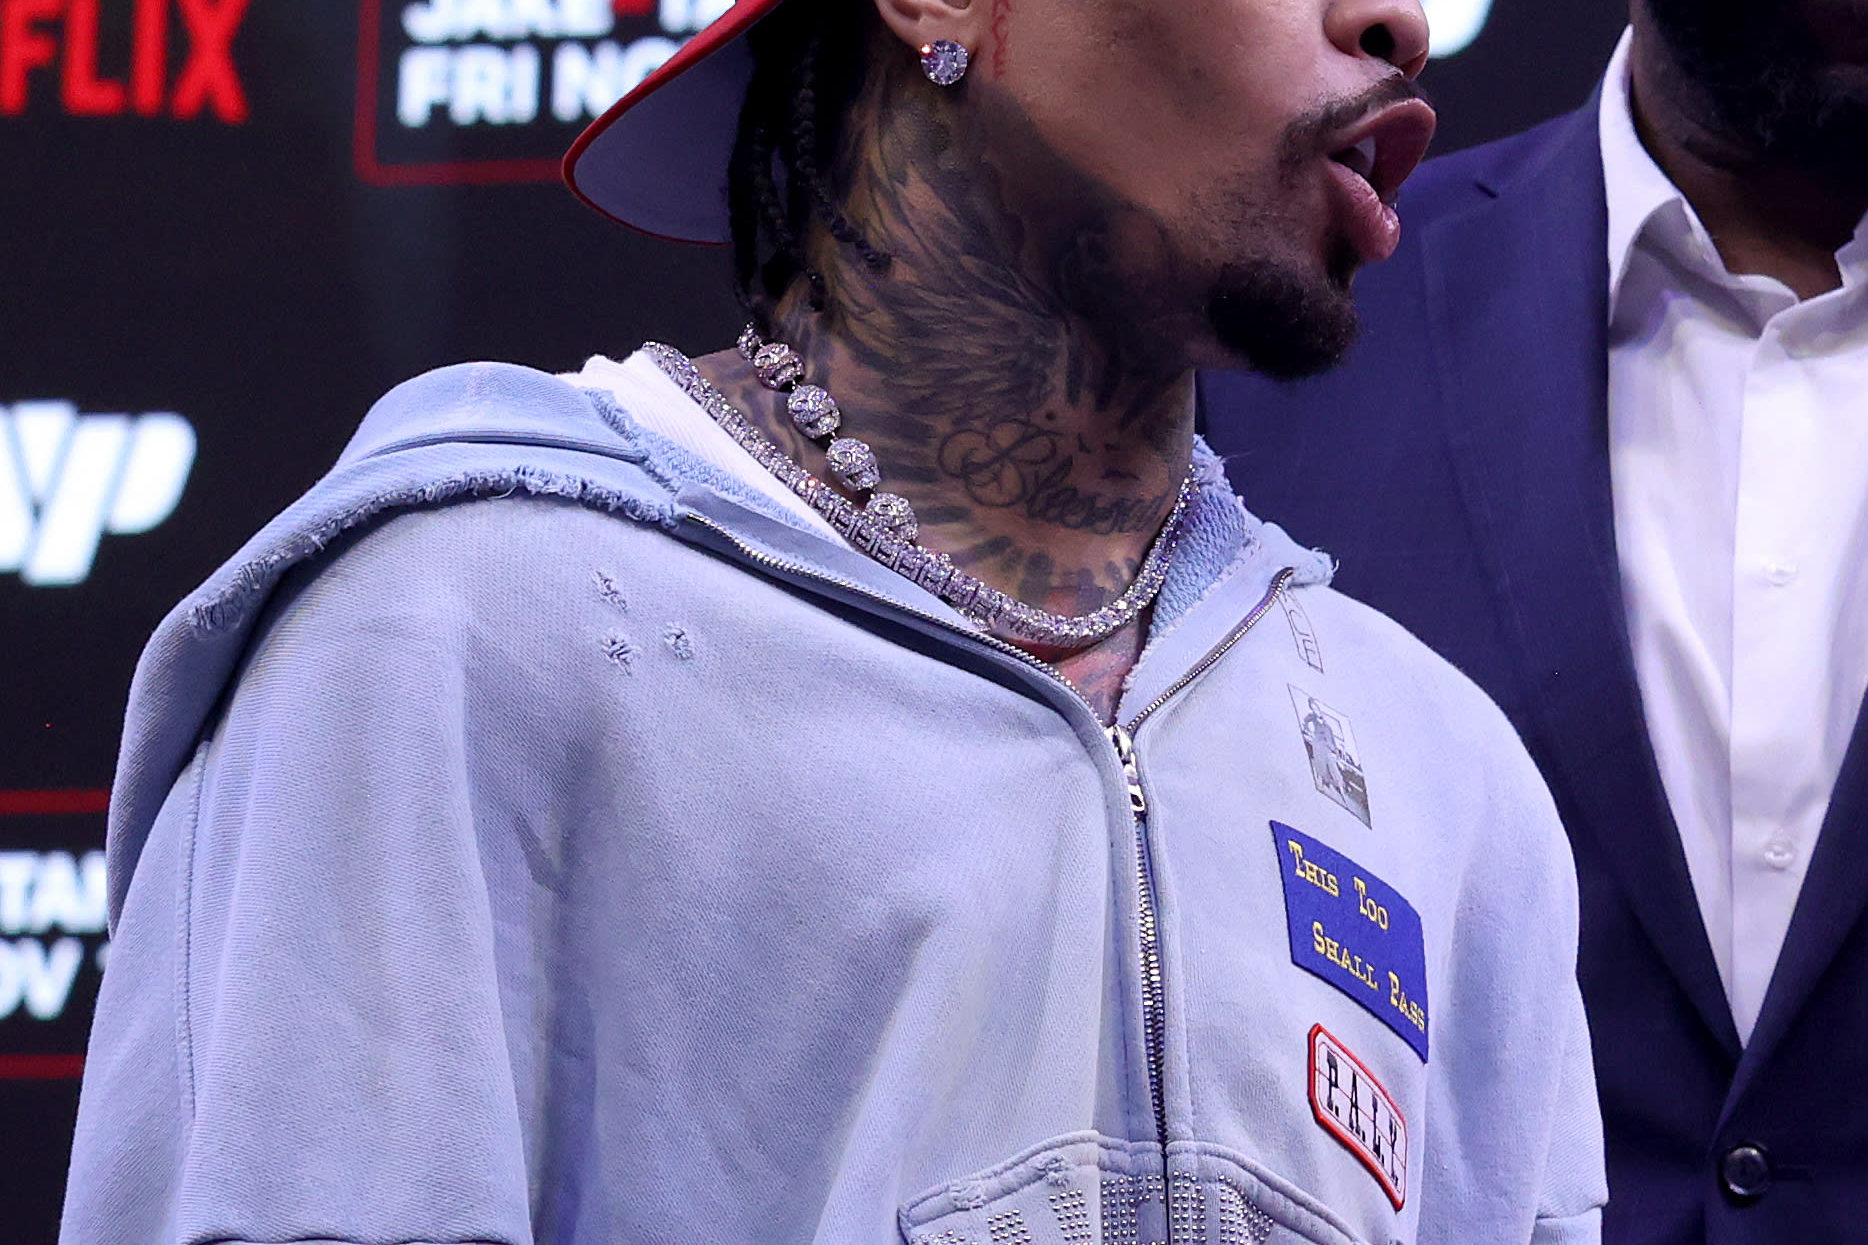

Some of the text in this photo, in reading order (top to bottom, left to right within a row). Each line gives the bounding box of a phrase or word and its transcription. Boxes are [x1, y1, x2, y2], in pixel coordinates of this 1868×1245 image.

[397, 43, 541, 128] FRI
[1288, 840, 1390, 931] THIS TOO
[1312, 921, 1426, 1033] SHALL PASS
